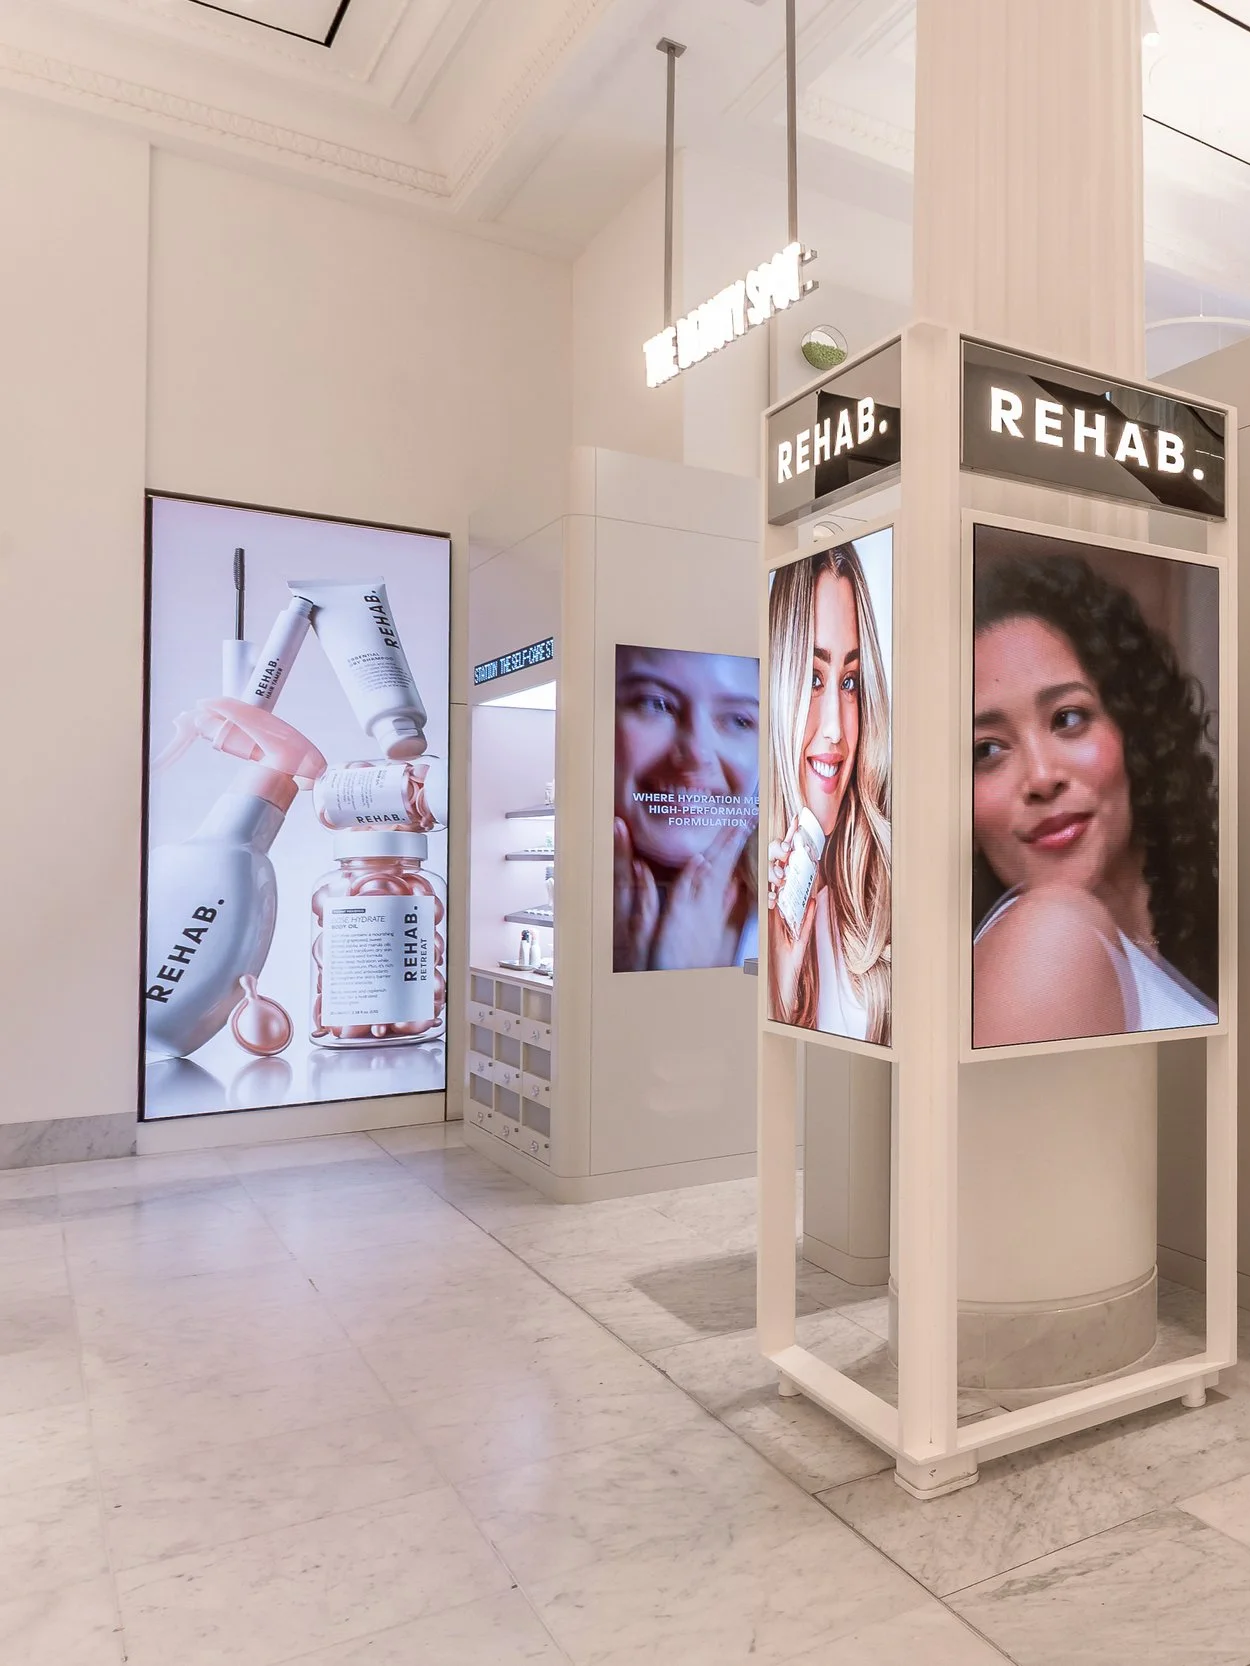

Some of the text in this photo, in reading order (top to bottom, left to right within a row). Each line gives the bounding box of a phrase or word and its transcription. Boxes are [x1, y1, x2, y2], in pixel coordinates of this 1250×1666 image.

[777, 396, 889, 484] REHAB.
[990, 385, 1206, 482] REHAB.
[364, 590, 401, 649] REHAB.
[255, 658, 280, 697] REHAB.
[500, 655, 511, 674] THE
[356, 813, 406, 824] REHAB.
[633, 793, 675, 802] WHERE
[678, 794, 740, 804] HYDRATION
[668, 817, 747, 827] FORMULATION
[351, 915, 386, 923] HYDRATE
[146, 899, 225, 1003] REHAB.
[404, 905, 418, 982] REHAB.
[420, 938, 428, 981] RETREAT
